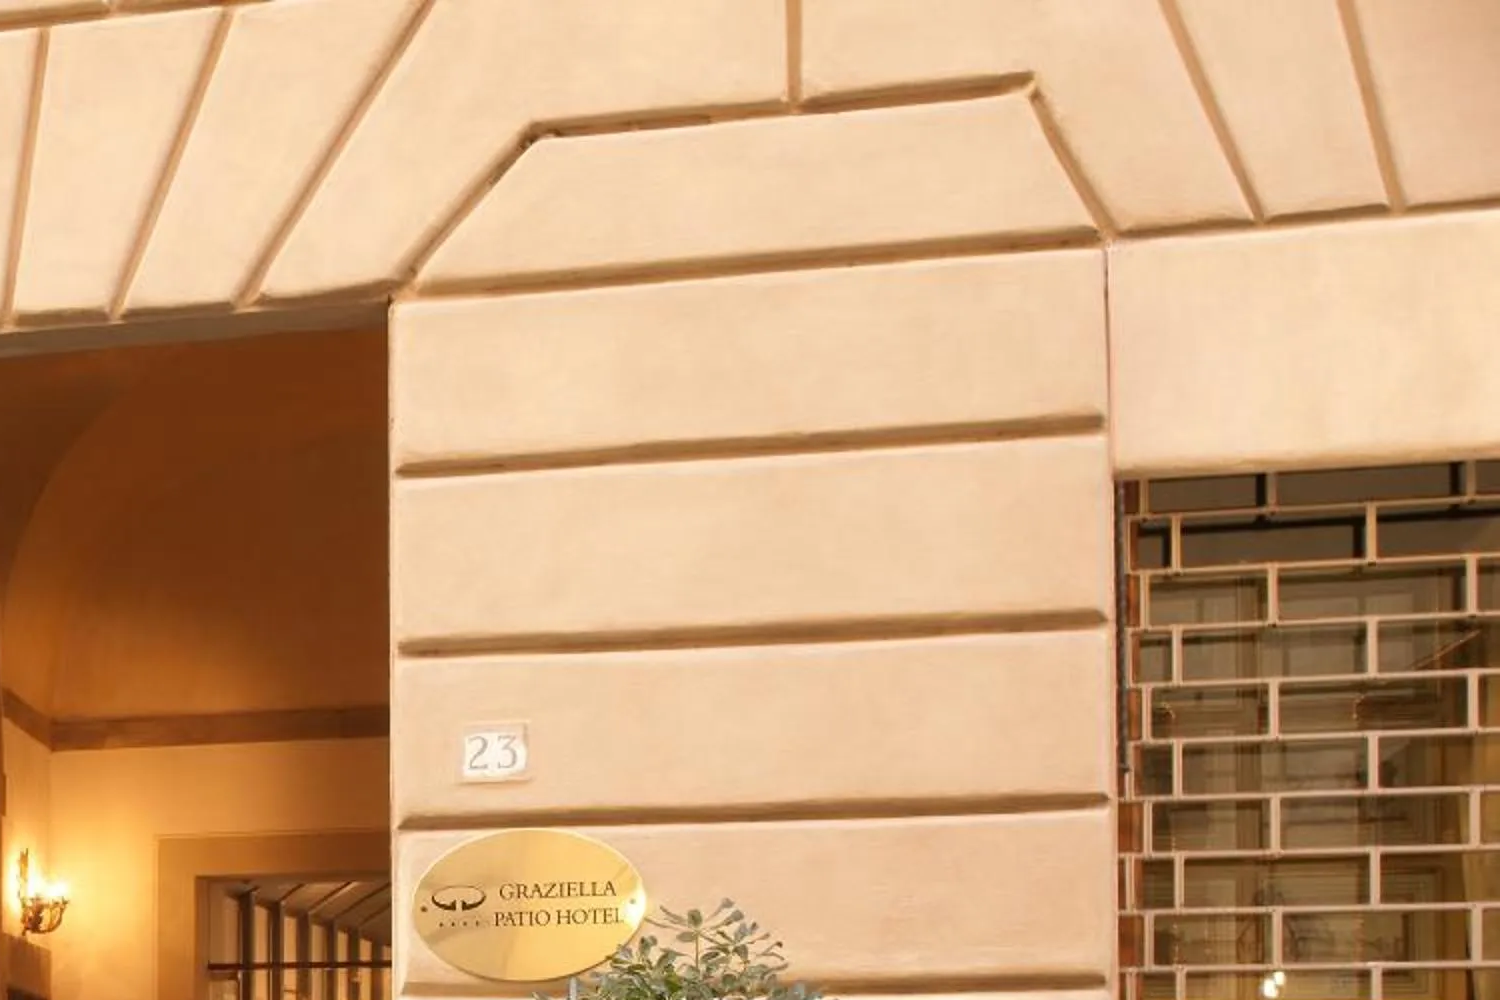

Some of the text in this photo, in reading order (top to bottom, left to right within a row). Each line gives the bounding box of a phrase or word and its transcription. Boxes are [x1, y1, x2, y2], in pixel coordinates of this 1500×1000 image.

[468, 735, 517, 770] 23
[499, 881, 617, 900] GRAZIELLA
[494, 907, 625, 928] PATIO HOTEL
